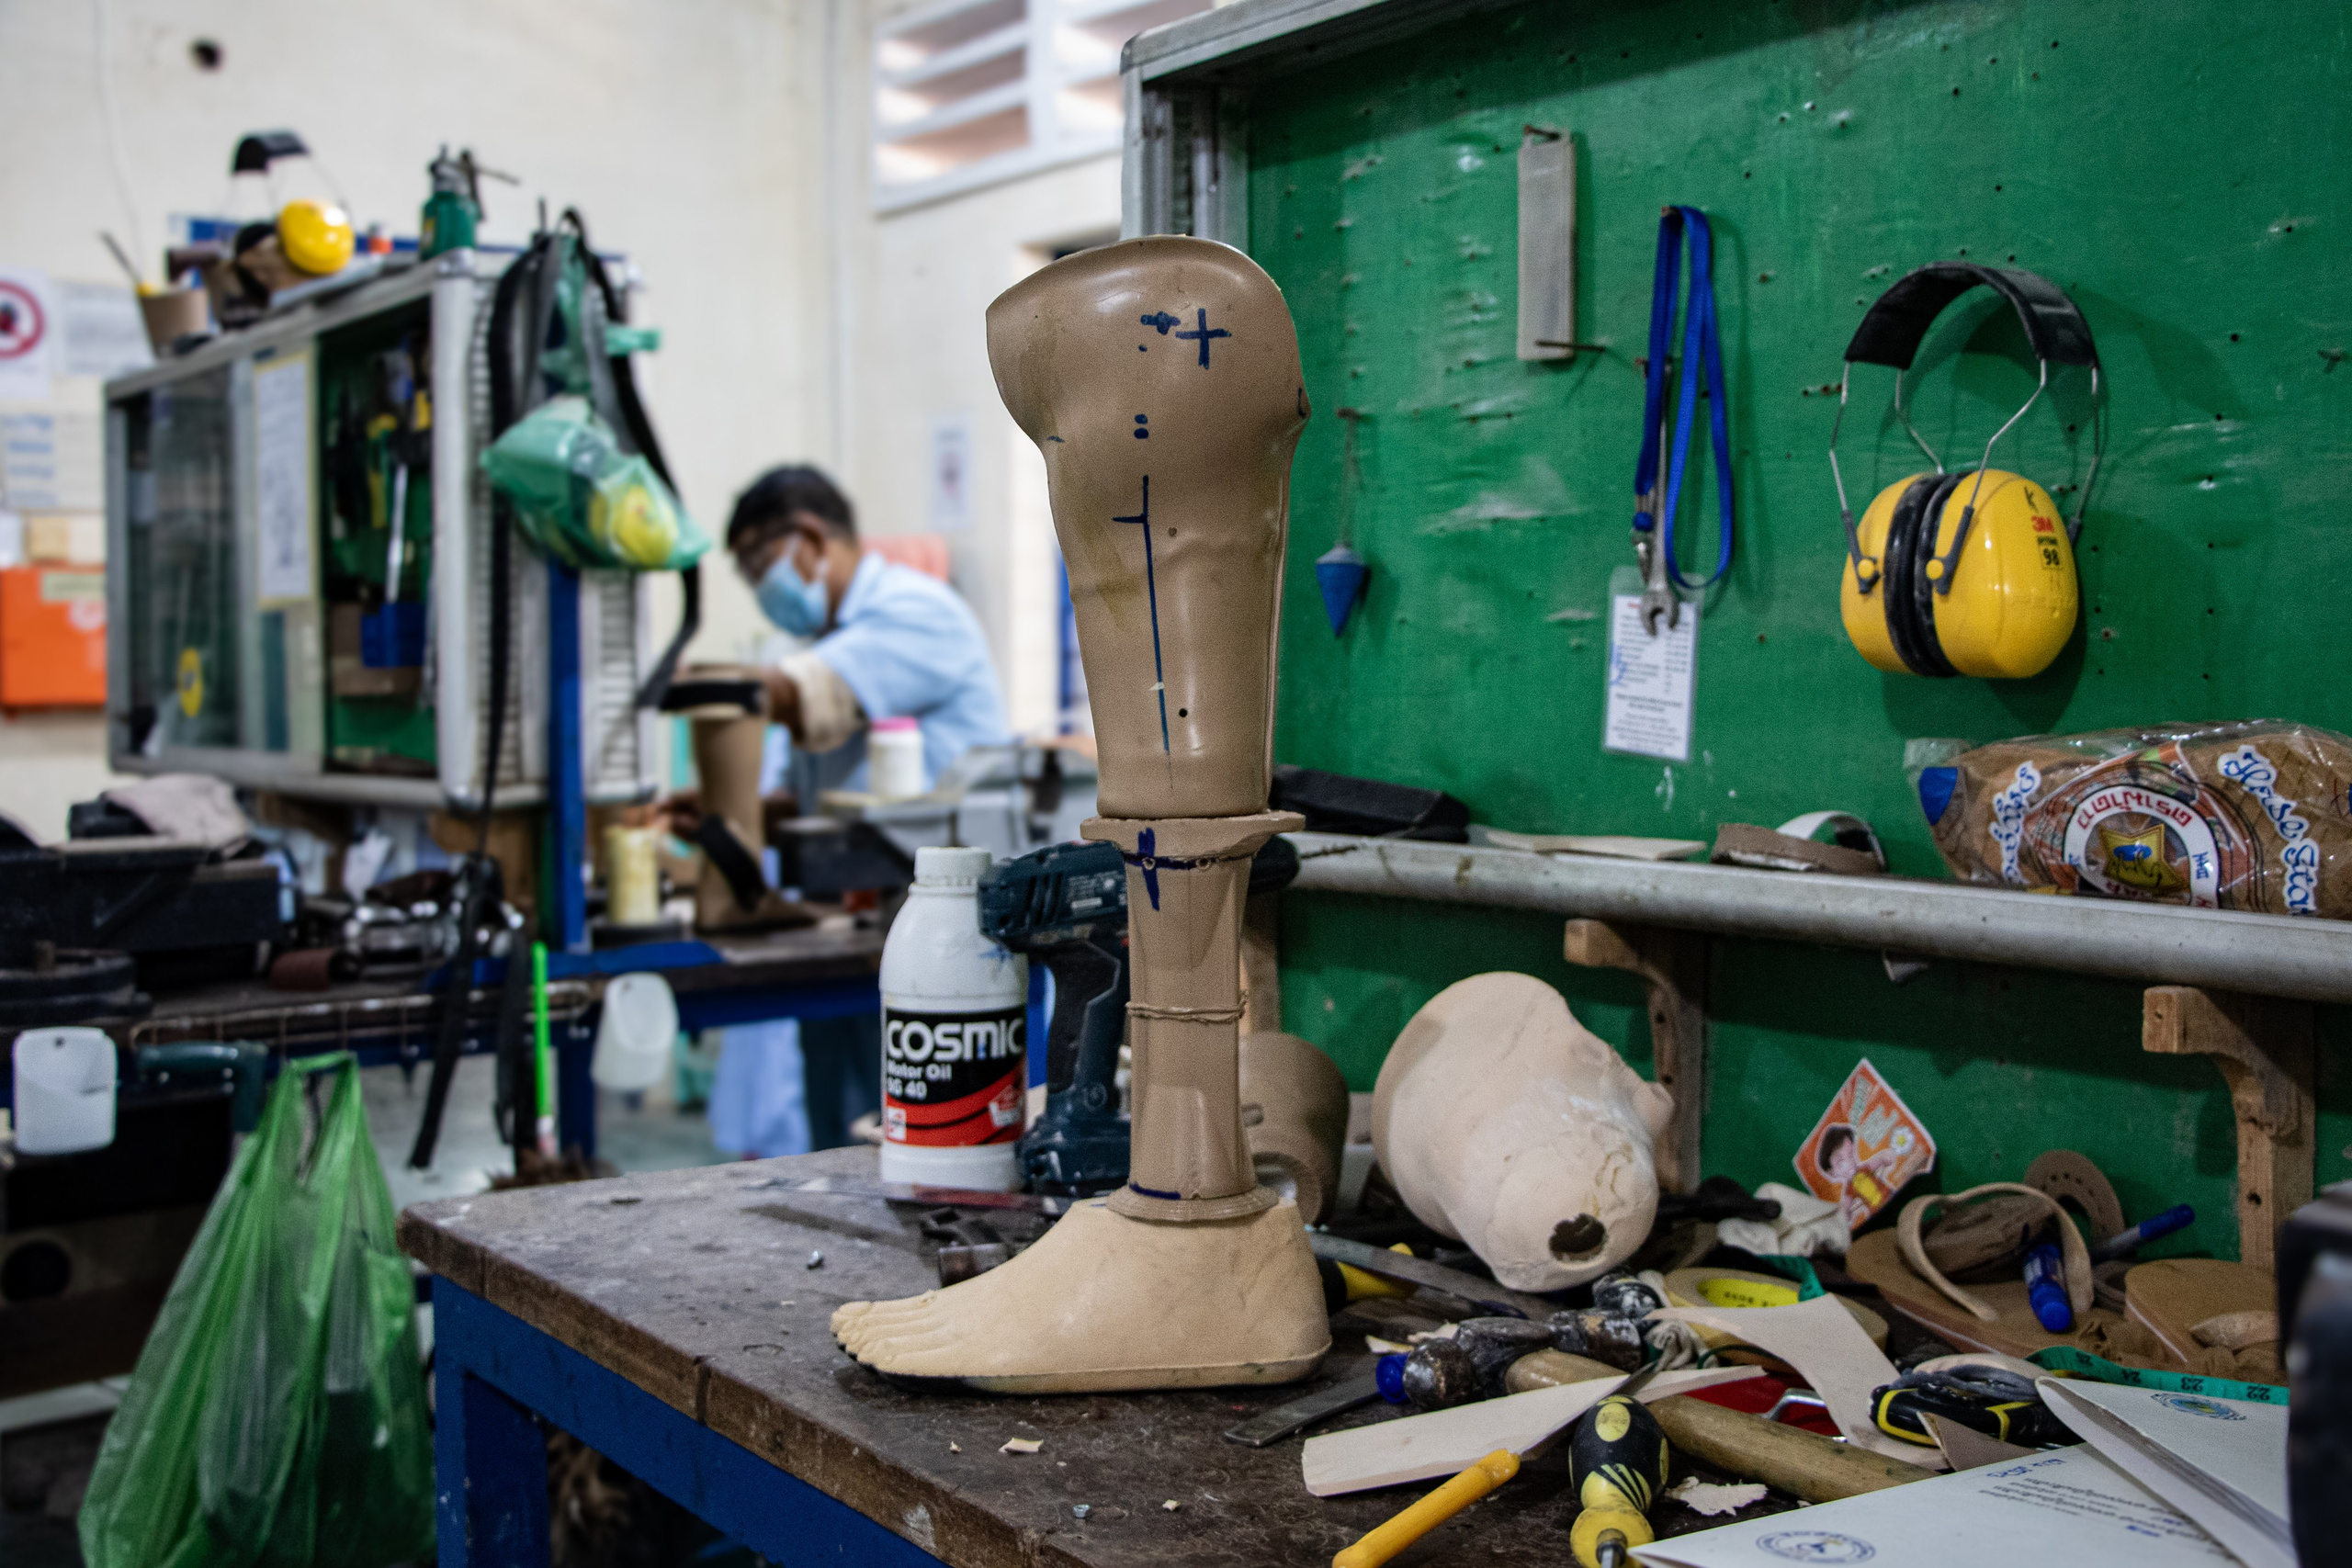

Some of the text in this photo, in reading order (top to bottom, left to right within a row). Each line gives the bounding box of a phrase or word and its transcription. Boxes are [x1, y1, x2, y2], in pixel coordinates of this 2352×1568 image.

[2031, 516, 2054, 532] 3M
[888, 1020, 1024, 1062] COSMIC
[926, 1064, 952, 1081] Oil
[906, 1081, 927, 1100] 40
[2180, 1376, 2204, 1392] 23
[2246, 1385, 2270, 1401] 22
